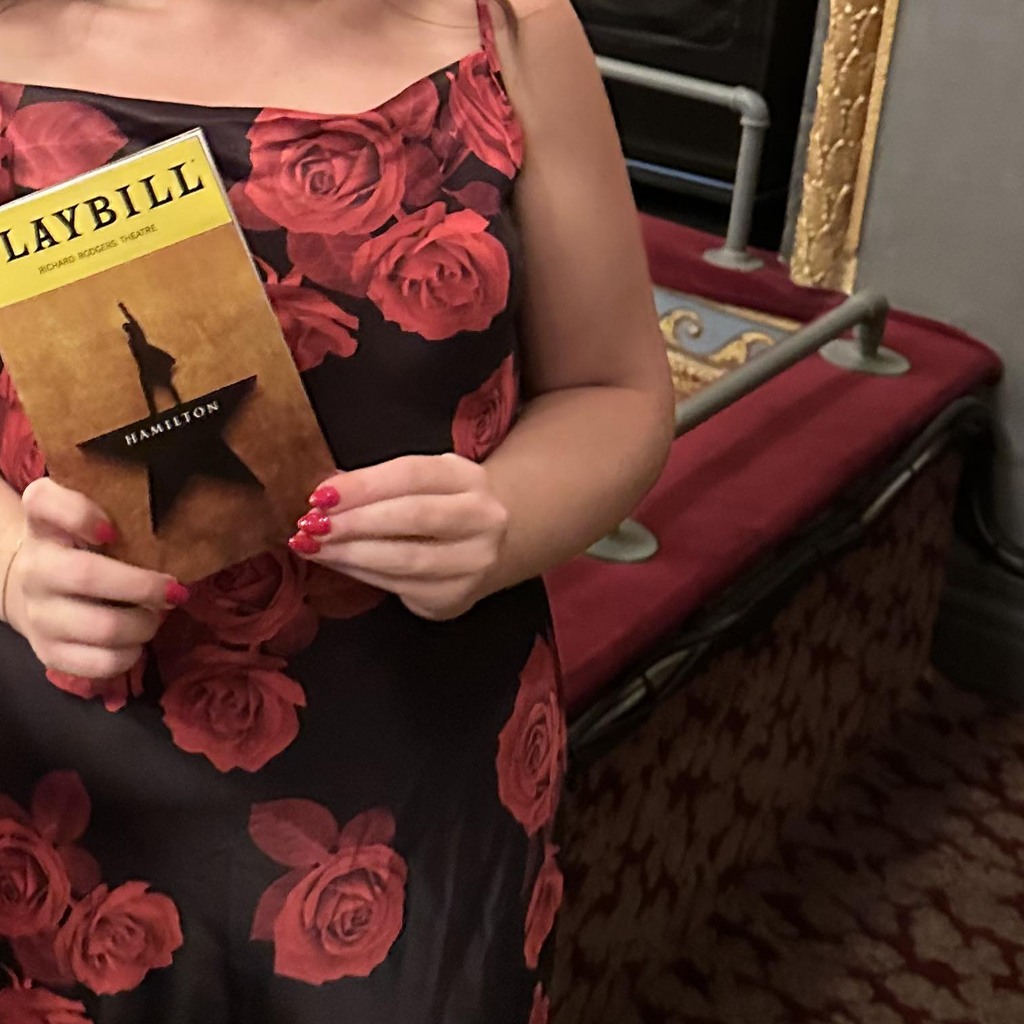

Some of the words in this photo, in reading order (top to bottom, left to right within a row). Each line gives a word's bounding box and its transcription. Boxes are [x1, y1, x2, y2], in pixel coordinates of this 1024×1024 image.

[38, 255, 76, 275] RICHARD
[77, 239, 118, 260] RODGERS
[120, 224, 157, 243] THEATRE
[125, 401, 219, 446] HAMILTON
